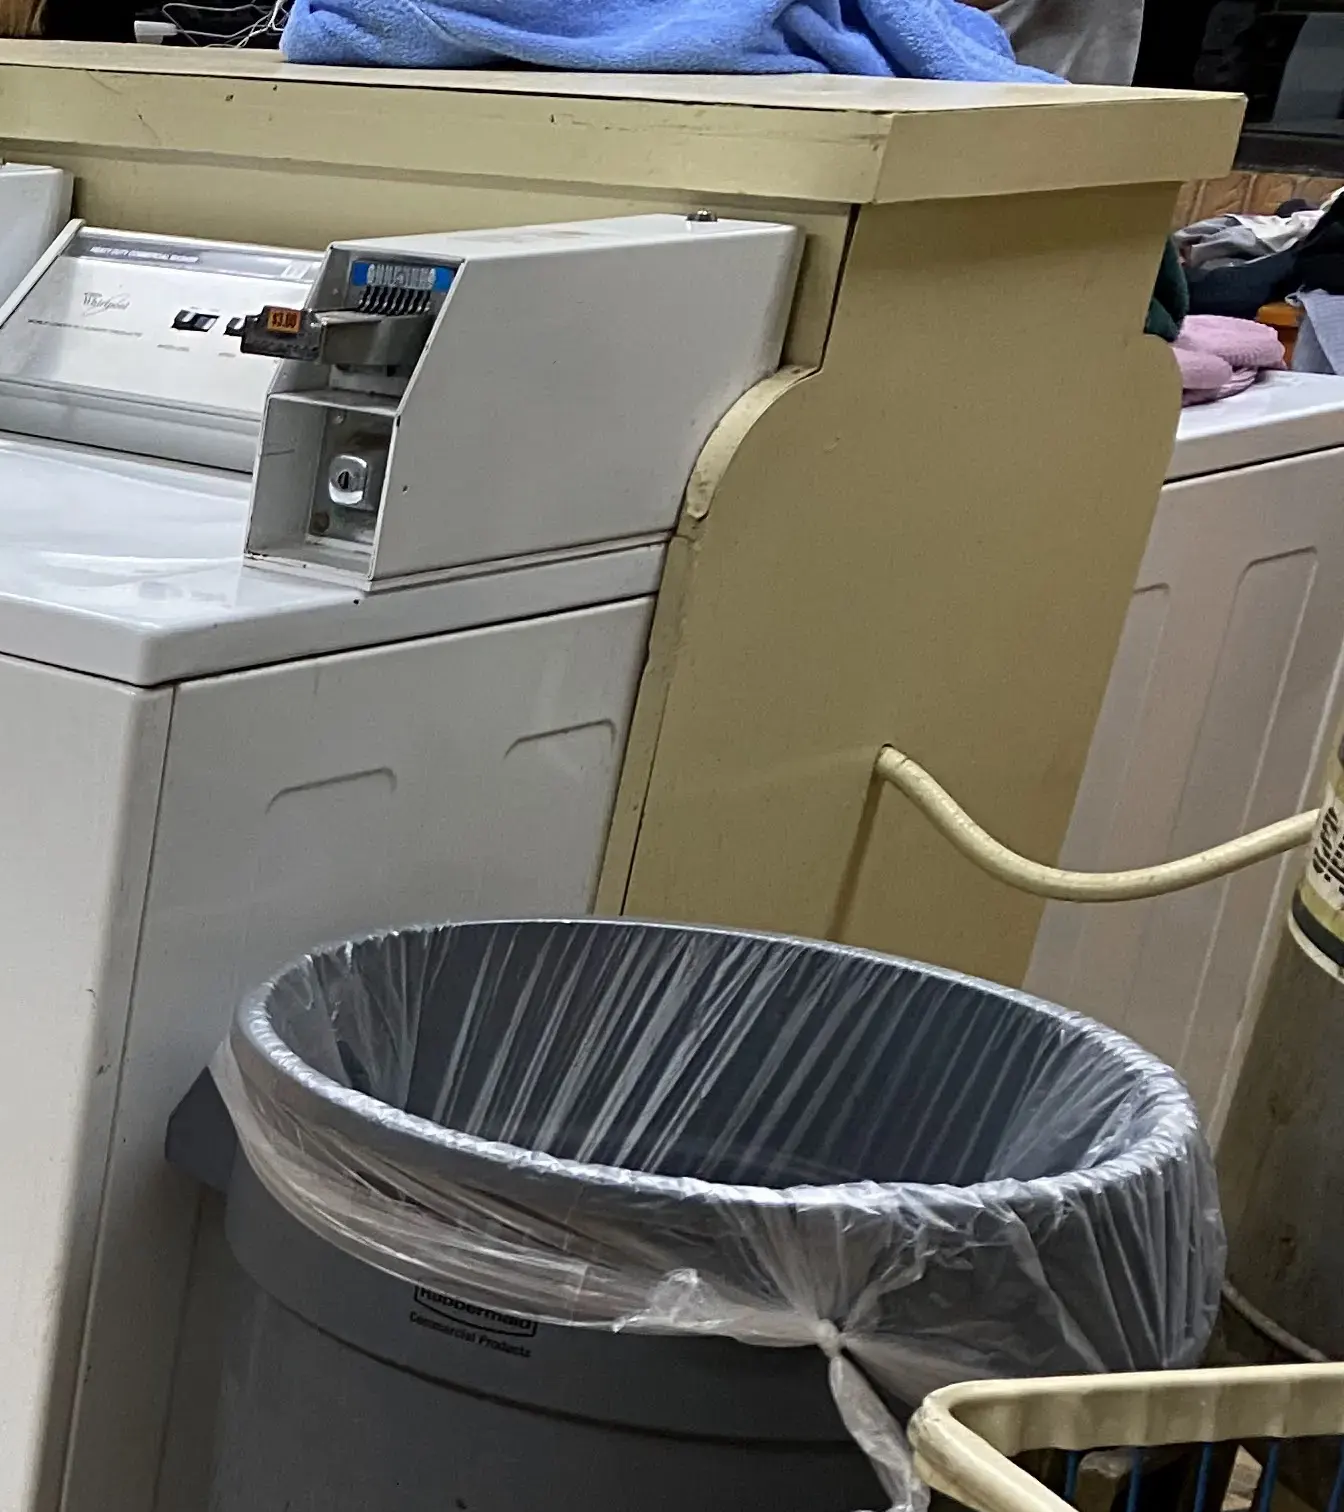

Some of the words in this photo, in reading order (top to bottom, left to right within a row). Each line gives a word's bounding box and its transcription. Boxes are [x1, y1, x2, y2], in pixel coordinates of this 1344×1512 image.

[83, 292, 130, 311] Whirlpool
[409, 1311, 476, 1343] Commercial
[478, 1334, 532, 1358] Products
